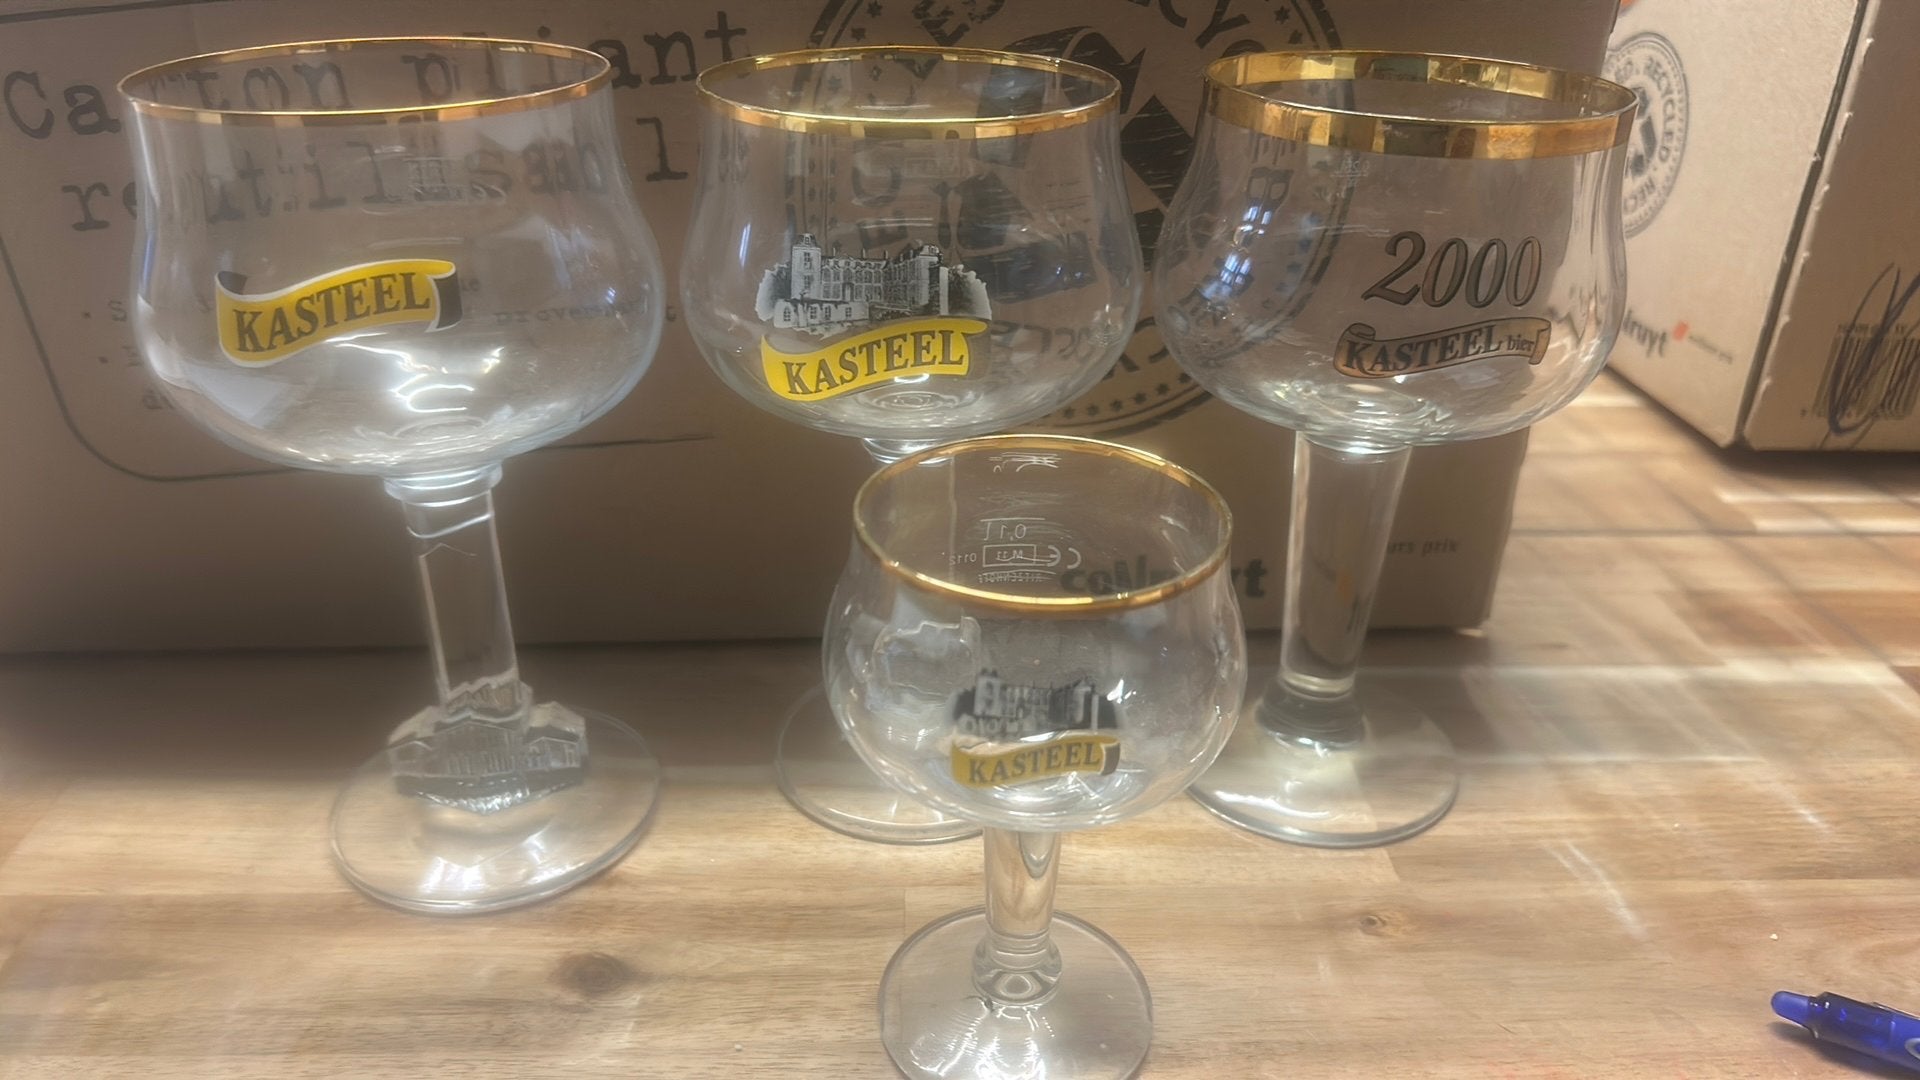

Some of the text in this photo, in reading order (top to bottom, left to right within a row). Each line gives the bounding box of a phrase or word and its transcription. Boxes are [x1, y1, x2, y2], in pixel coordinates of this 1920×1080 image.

[1362, 231, 1542, 309] 2000
[232, 271, 431, 353] KASTEEL
[782, 328, 966, 395] KASTEEL
[1342, 324, 1536, 377] KASTEEL bier
[968, 740, 1103, 784] KASTEEL
